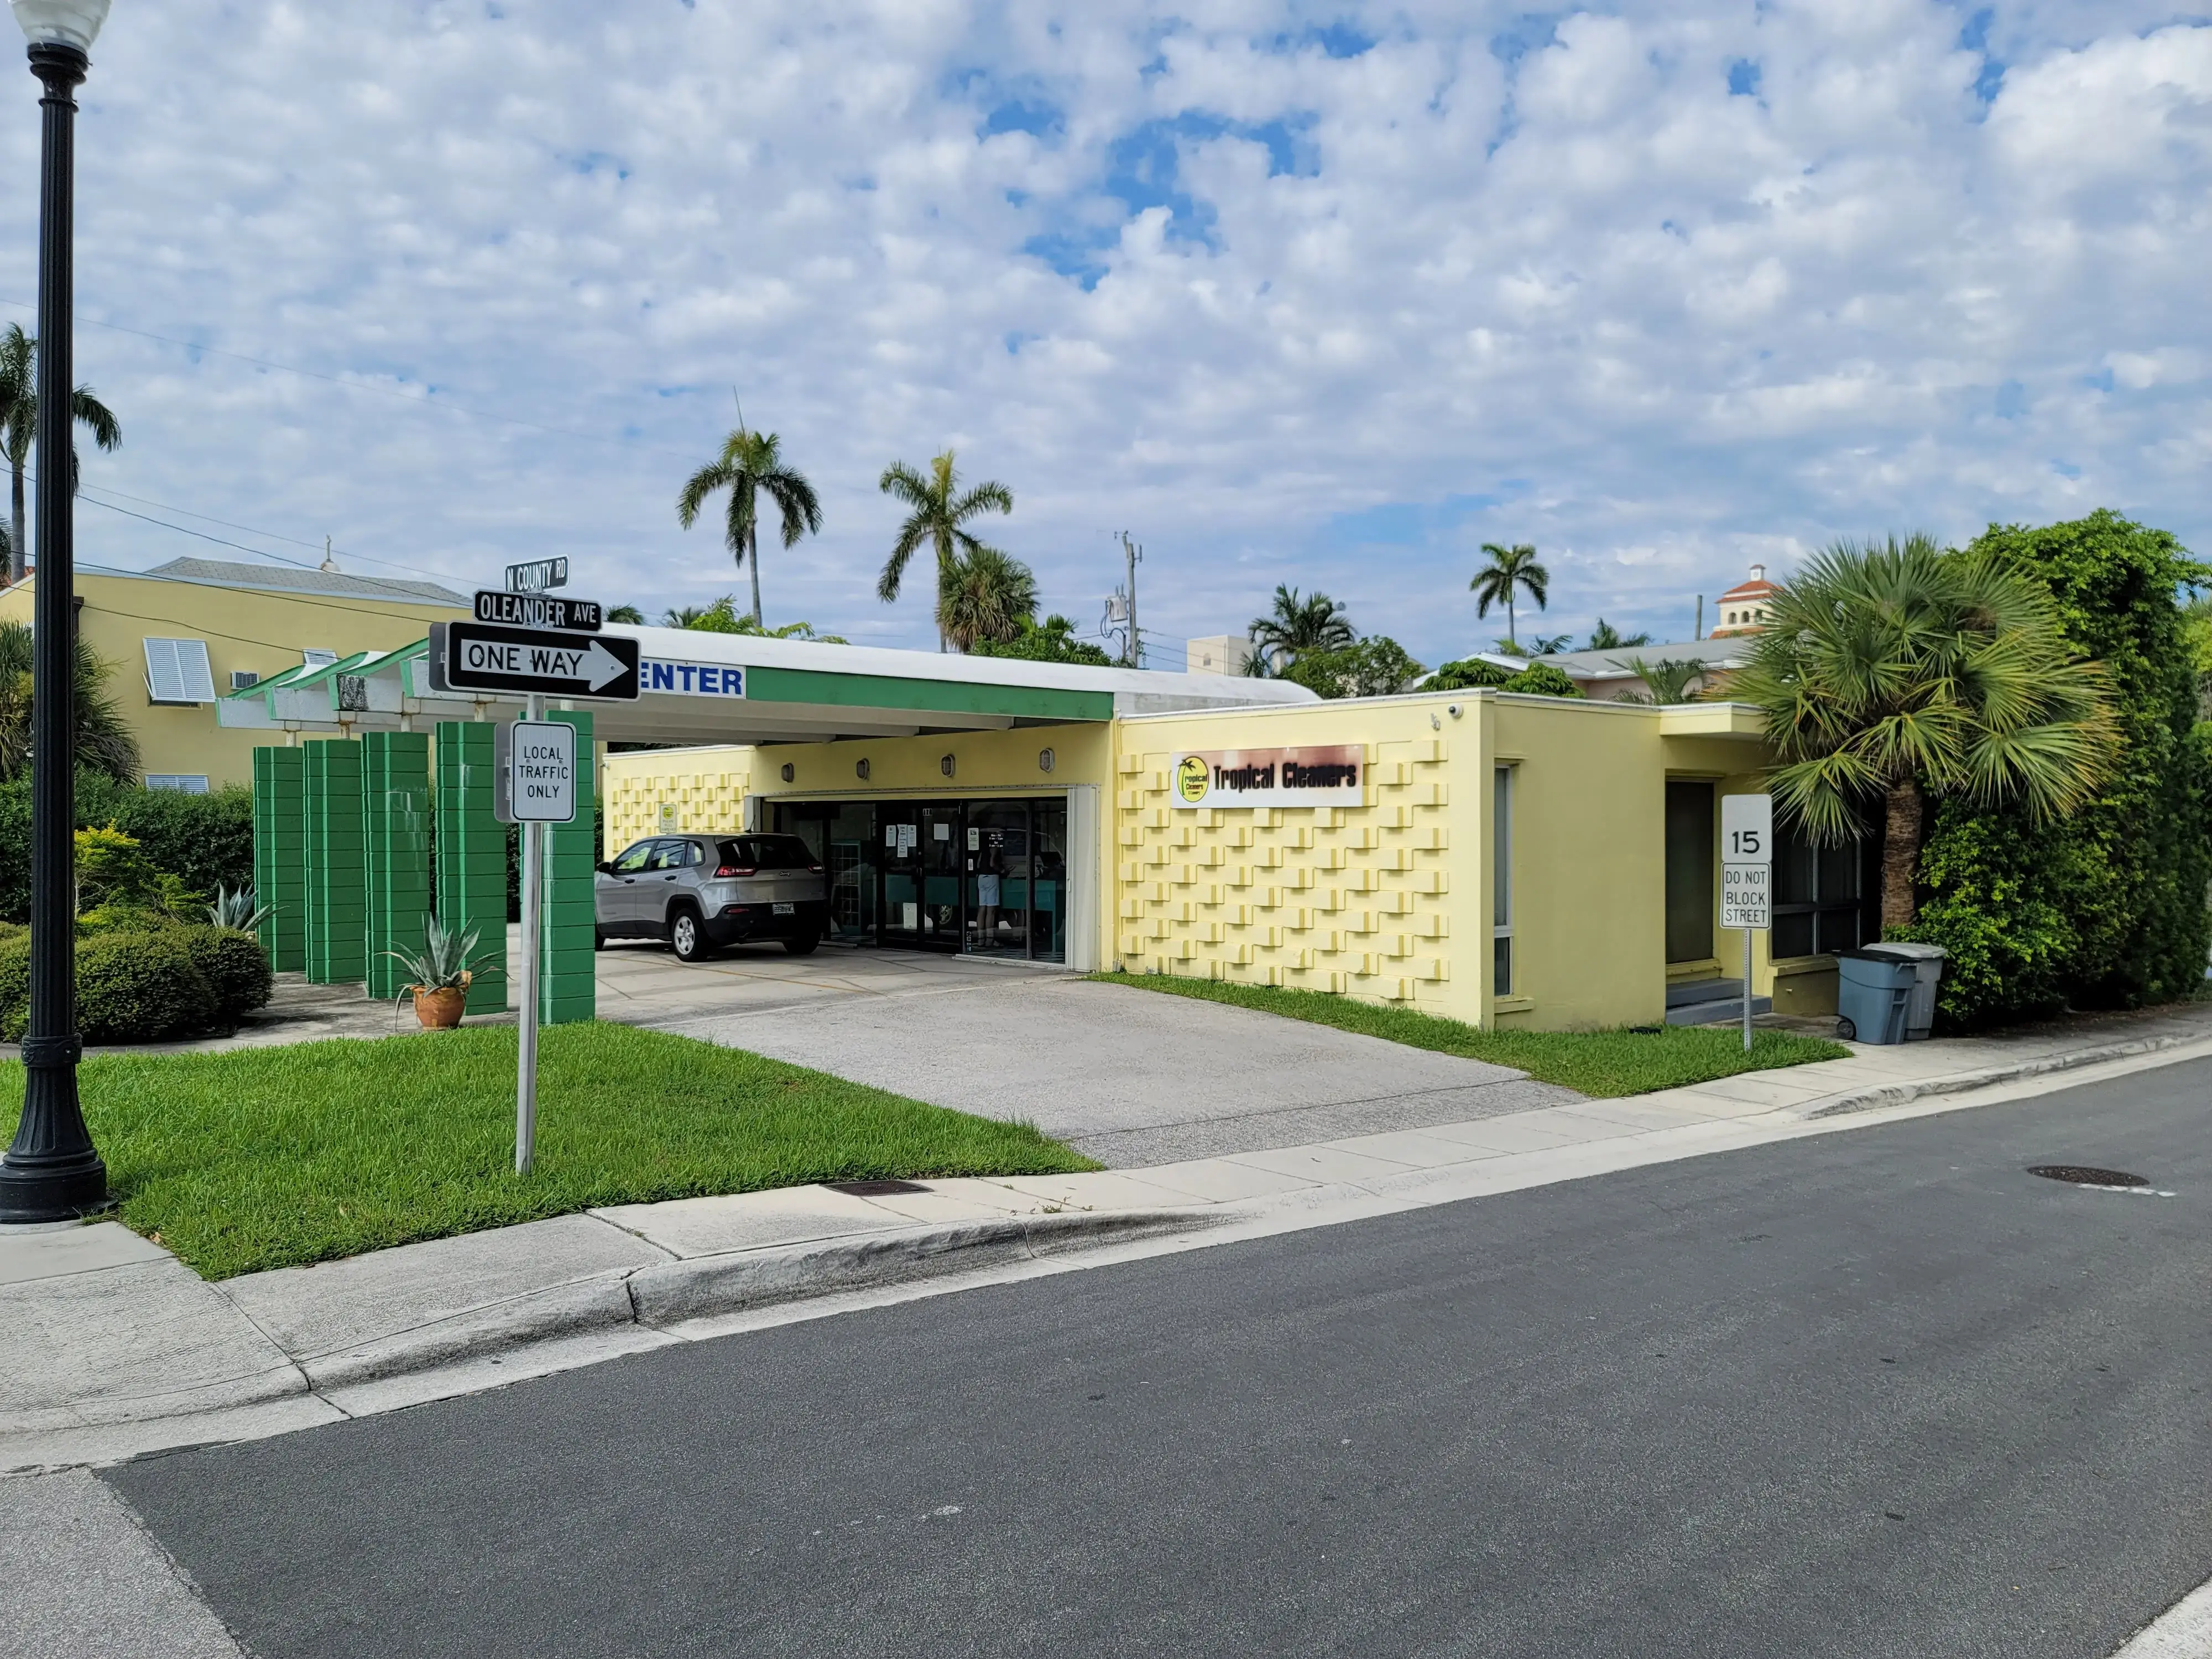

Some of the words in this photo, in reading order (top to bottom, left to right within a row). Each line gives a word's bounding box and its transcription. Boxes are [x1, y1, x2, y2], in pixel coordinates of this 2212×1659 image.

[507, 567, 514, 592] N
[517, 562, 552, 590] COUNTY
[556, 559, 566, 578] RD
[480, 594, 565, 626] OLEANDER
[574, 603, 597, 623] AVE
[469, 644, 521, 671] ONE
[531, 649, 584, 676] WAY
[524, 746, 564, 760] LOCAL
[519, 765, 568, 779] TRAFFIC
[1214, 763, 1274, 793] Tropical
[1282, 763, 1356, 788] Cleaners
[528, 785, 560, 798] ONLY
[1732, 831, 1760, 854] 15
[1726, 871, 1740, 884] DO
[1745, 871, 1766, 884] NOT
[1726, 892, 1765, 906] BLOCK
[1725, 909, 1766, 923] STREET
